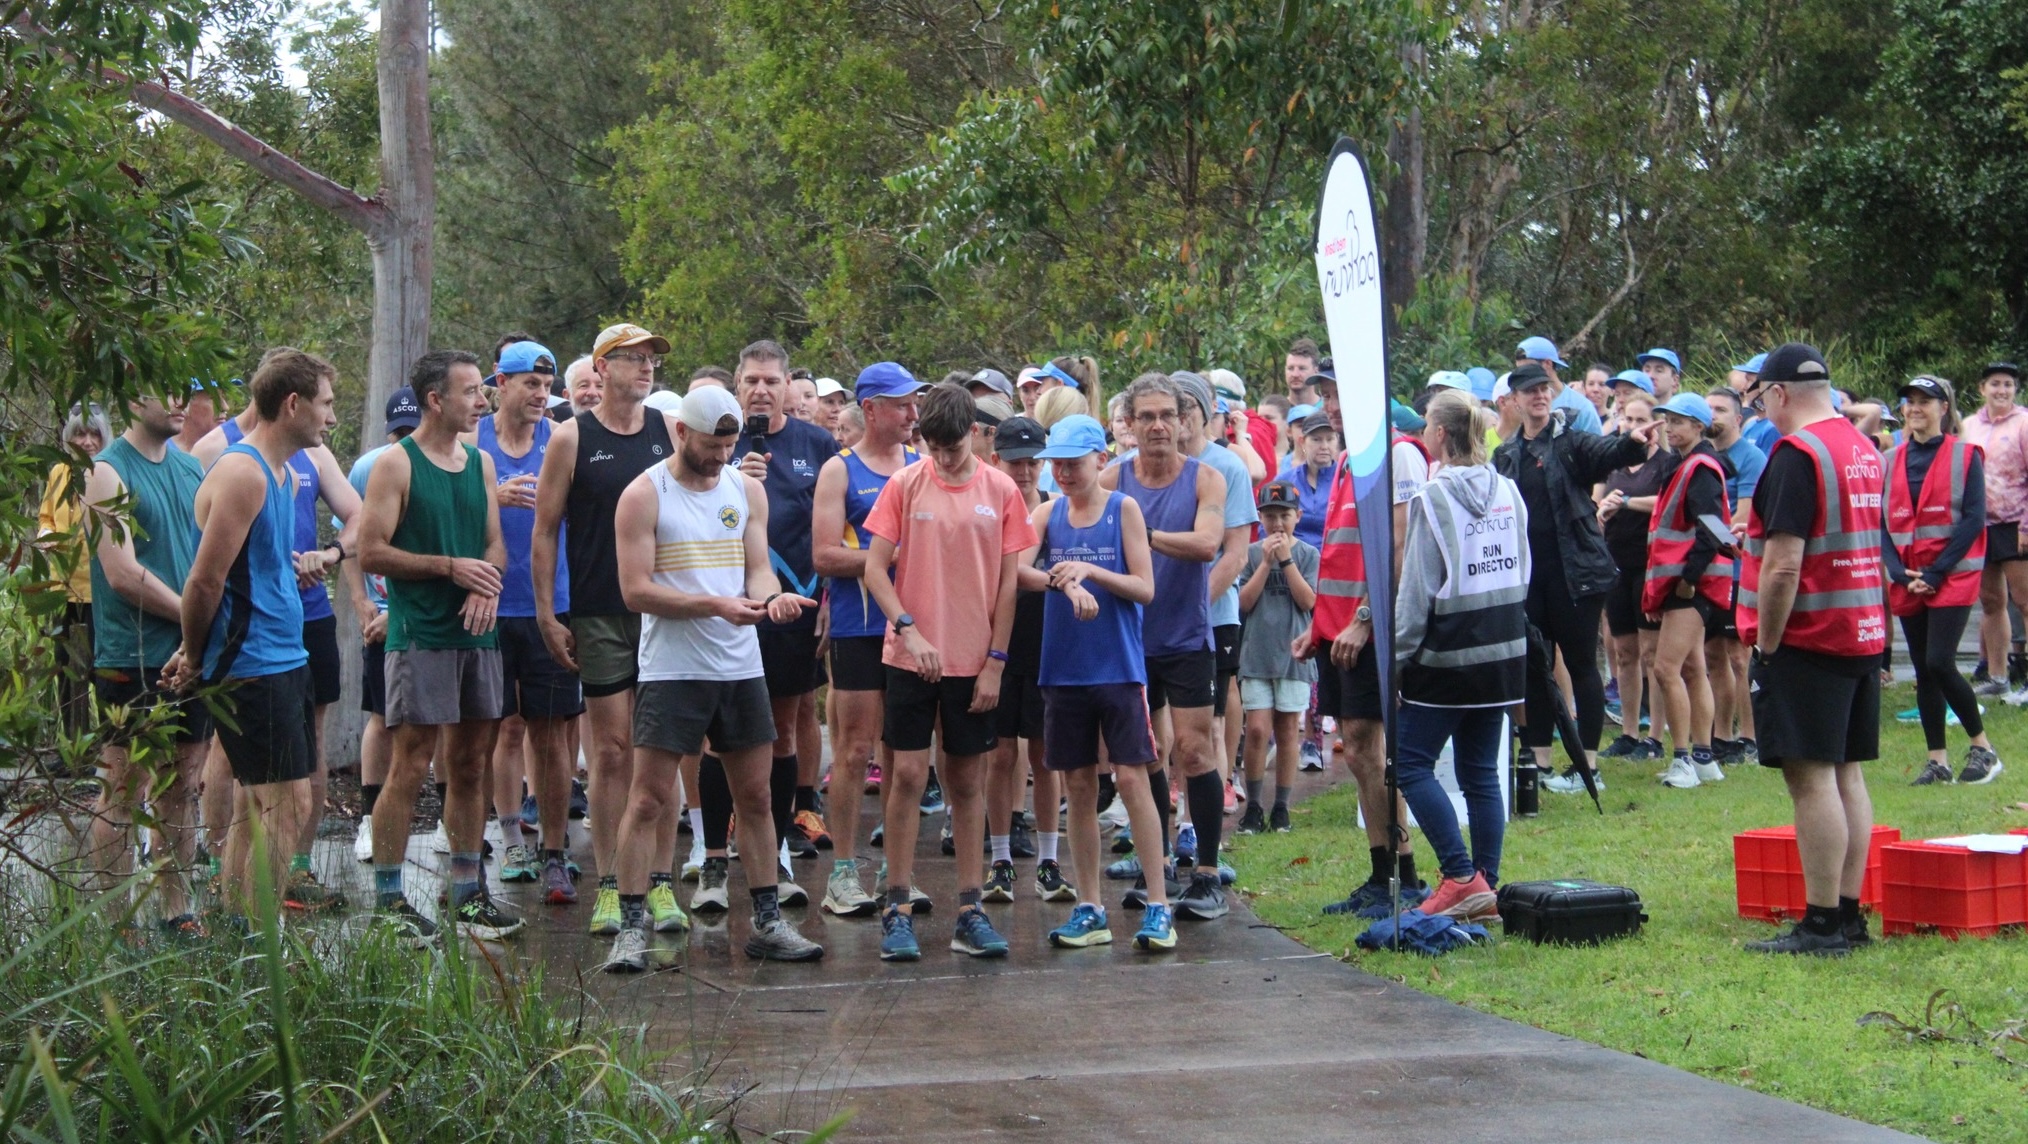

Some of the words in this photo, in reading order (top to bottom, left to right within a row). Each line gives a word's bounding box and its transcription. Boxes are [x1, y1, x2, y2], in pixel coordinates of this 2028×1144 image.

[393, 405, 417, 413] ASCOT
[590, 450, 614, 463] parkrun
[1465, 514, 1516, 540] parkrun
[1482, 544, 1502, 558] RUN
